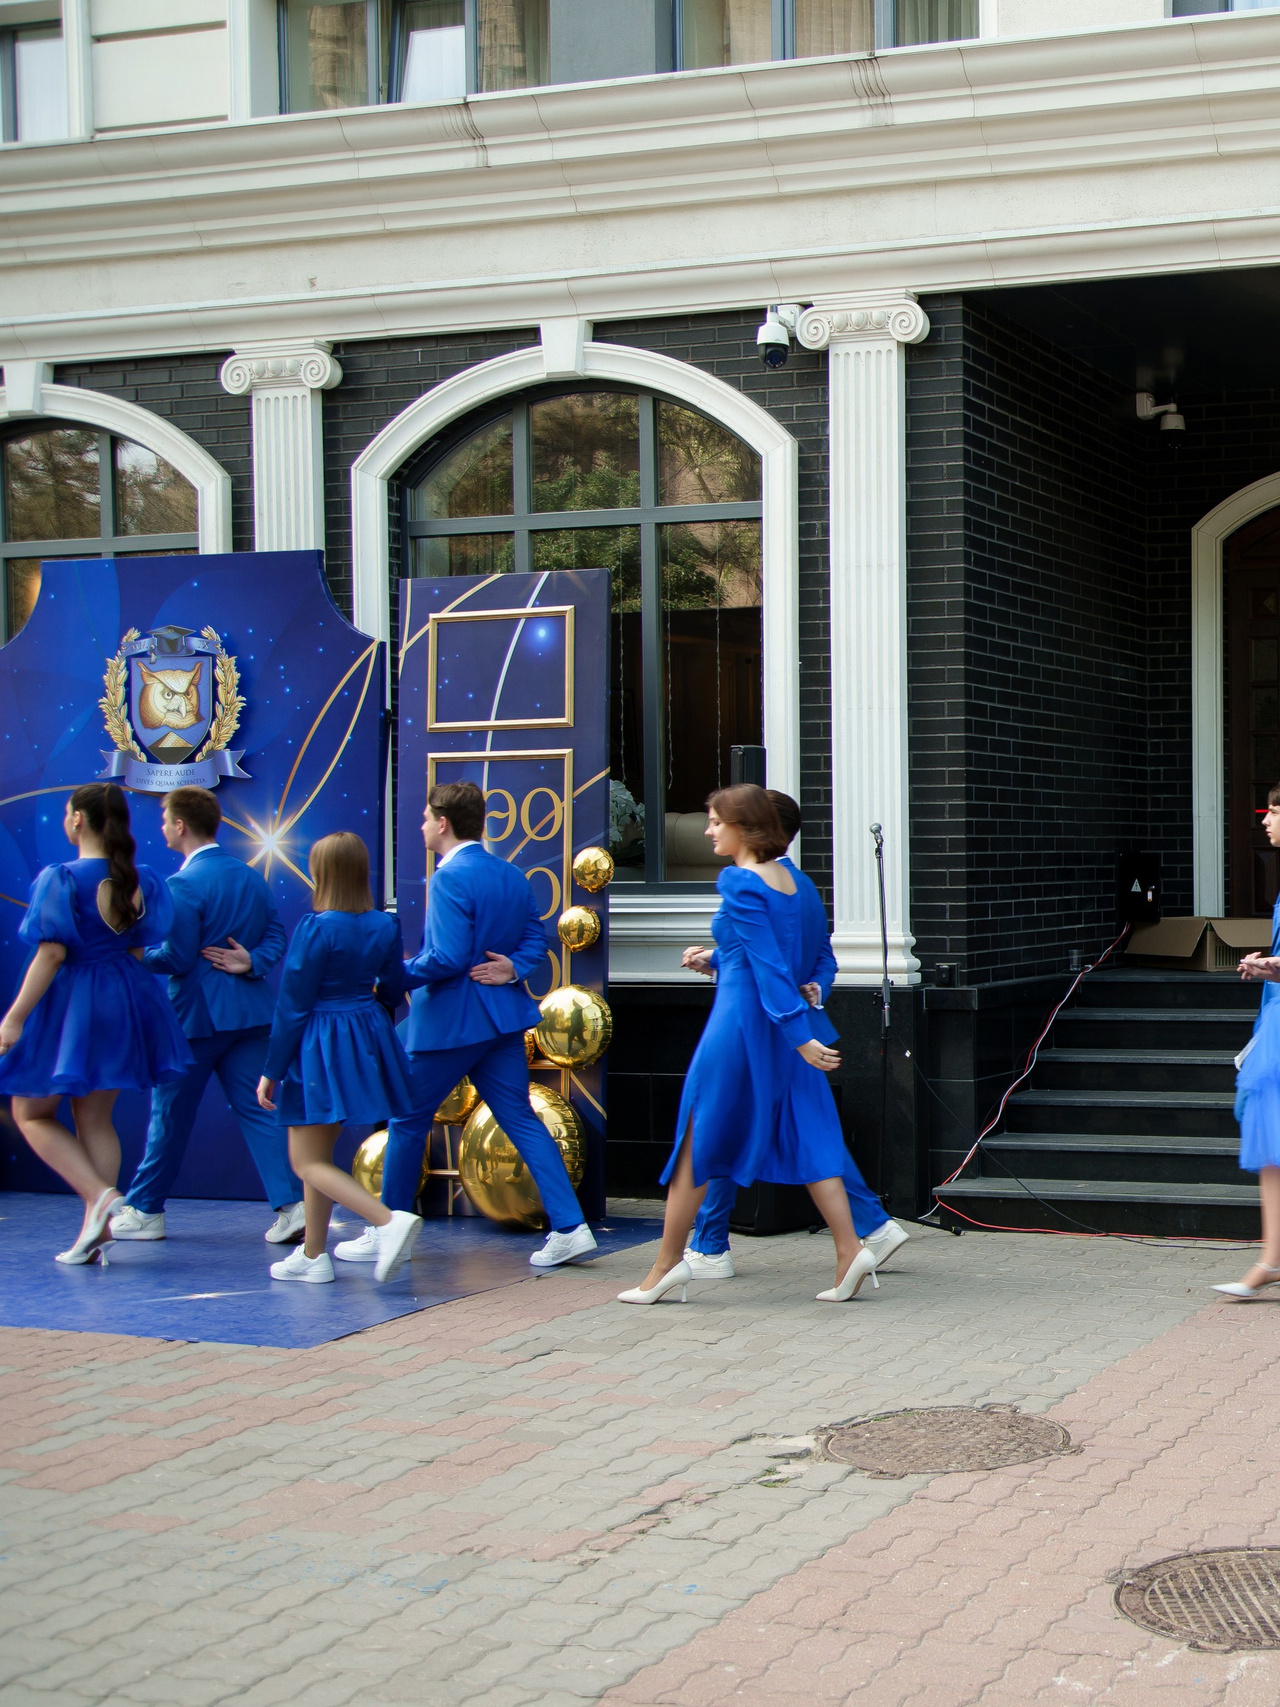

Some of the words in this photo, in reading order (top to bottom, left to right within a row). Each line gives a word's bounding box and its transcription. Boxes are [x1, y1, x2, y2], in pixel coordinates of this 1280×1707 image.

[175, 768, 196, 777] AUDE
[135, 777, 154, 786] DIVES
[155, 779, 175, 787] QUAM
[176, 777, 207, 786] SCIENTIA
[481, 787, 563, 842] ЭО
